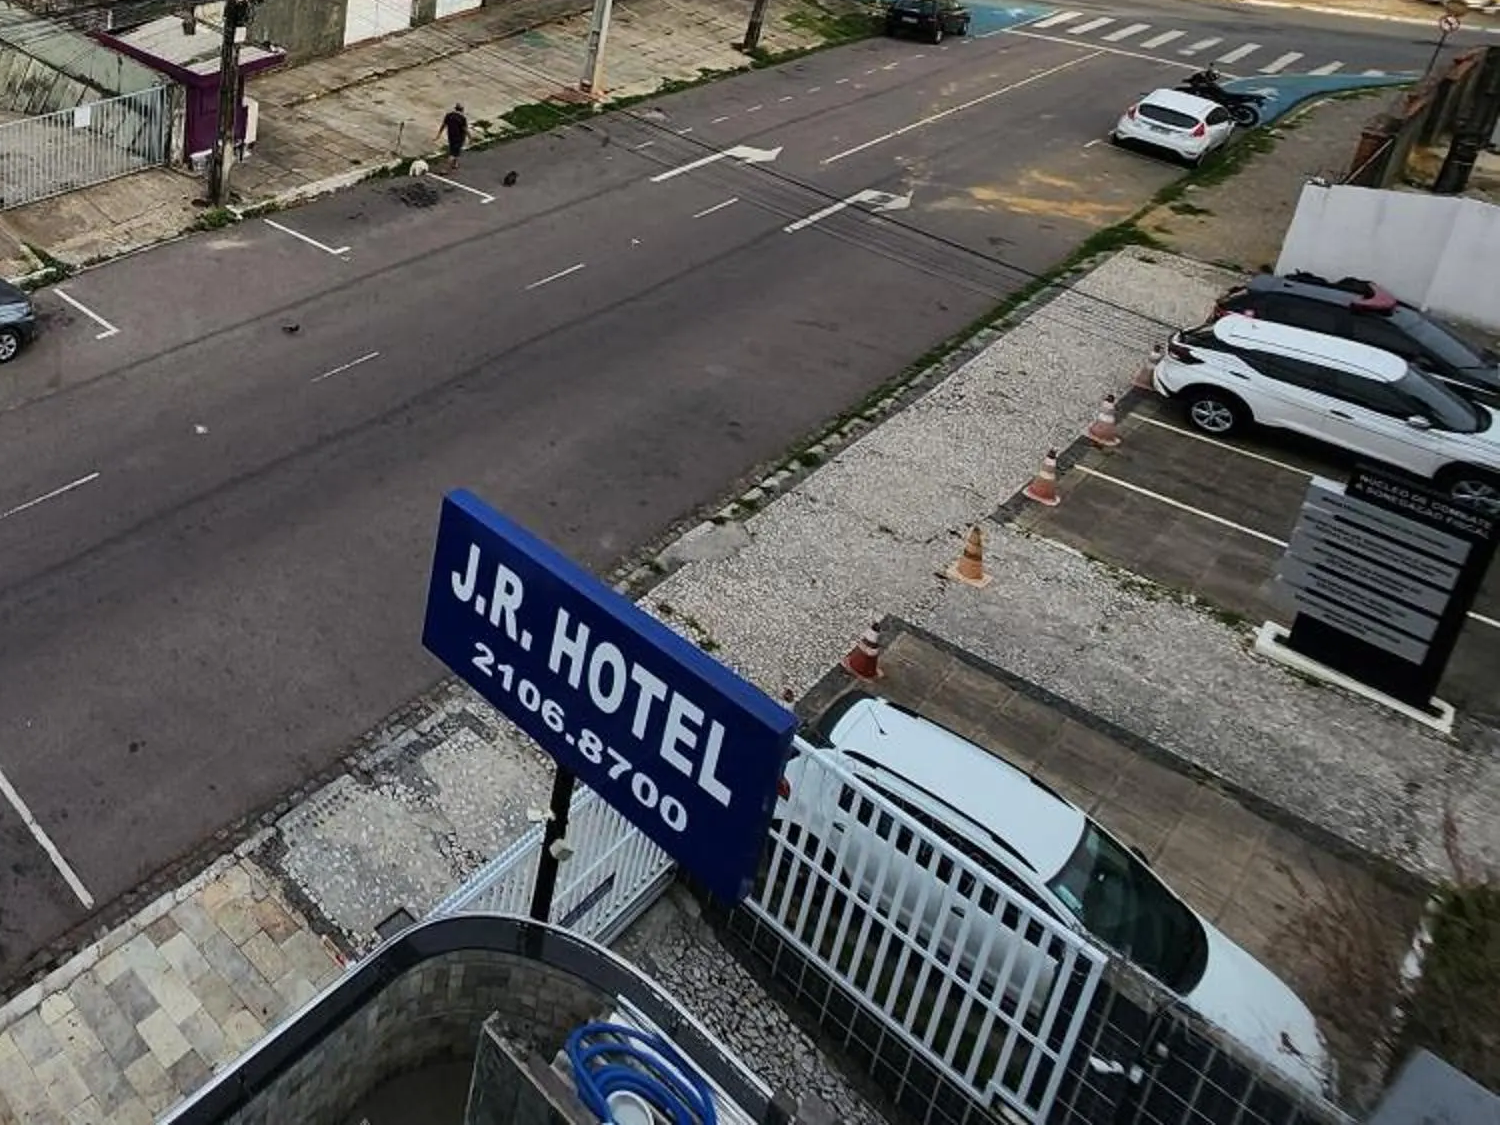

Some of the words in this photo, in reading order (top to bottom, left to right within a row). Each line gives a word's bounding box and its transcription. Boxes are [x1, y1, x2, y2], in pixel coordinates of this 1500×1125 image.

[451, 543, 533, 651] J.R.
[548, 607, 733, 807] HOTEL
[471, 642, 688, 833] 2106.8700
